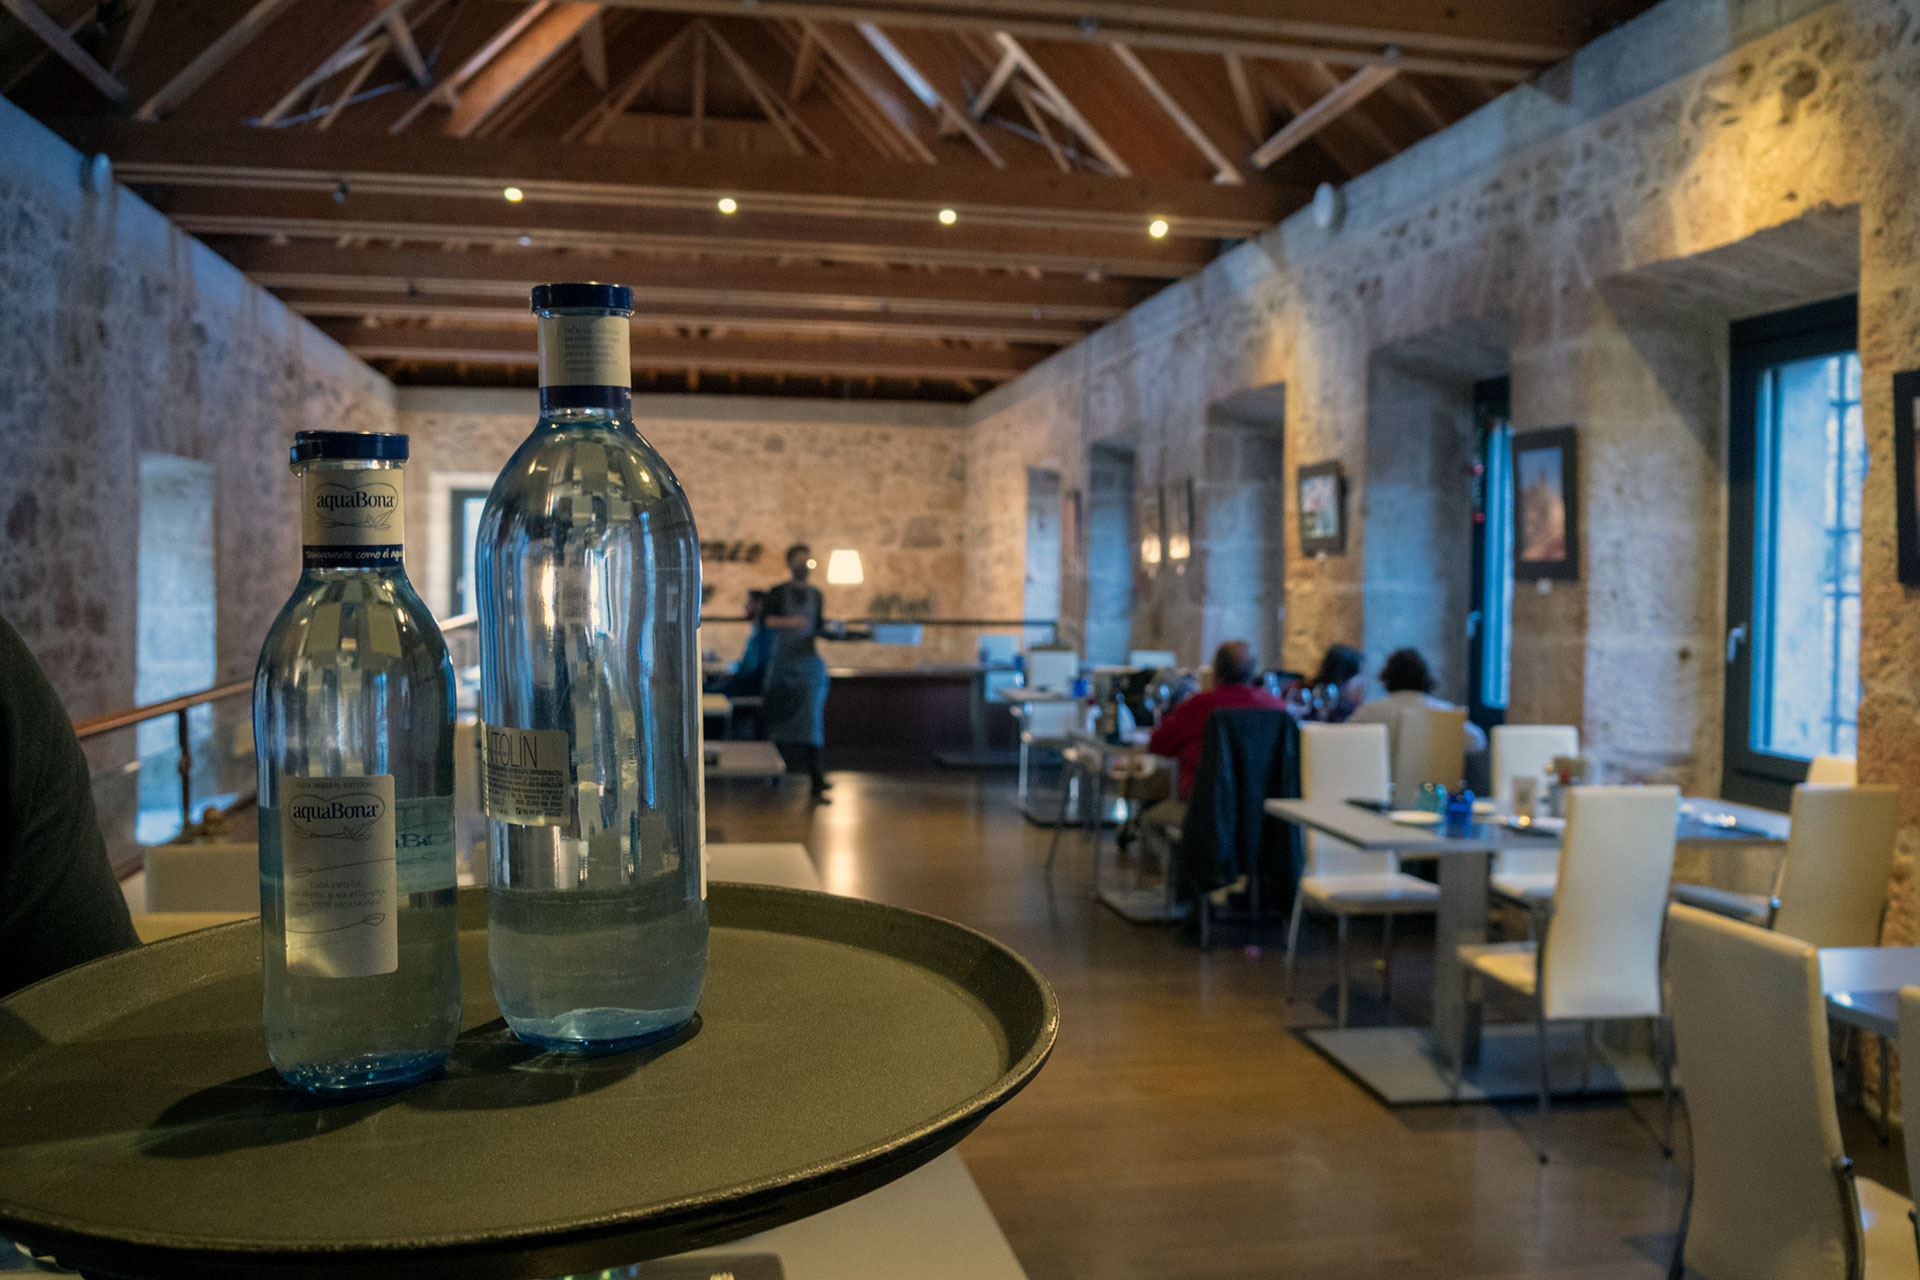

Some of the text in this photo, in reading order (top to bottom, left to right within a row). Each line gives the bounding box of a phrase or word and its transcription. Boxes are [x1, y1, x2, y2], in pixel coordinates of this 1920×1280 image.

[316, 491, 394, 511] aquaBona
[355, 550, 381, 560] como
[382, 548, 390, 559] el
[293, 802, 377, 822] aquaBona
